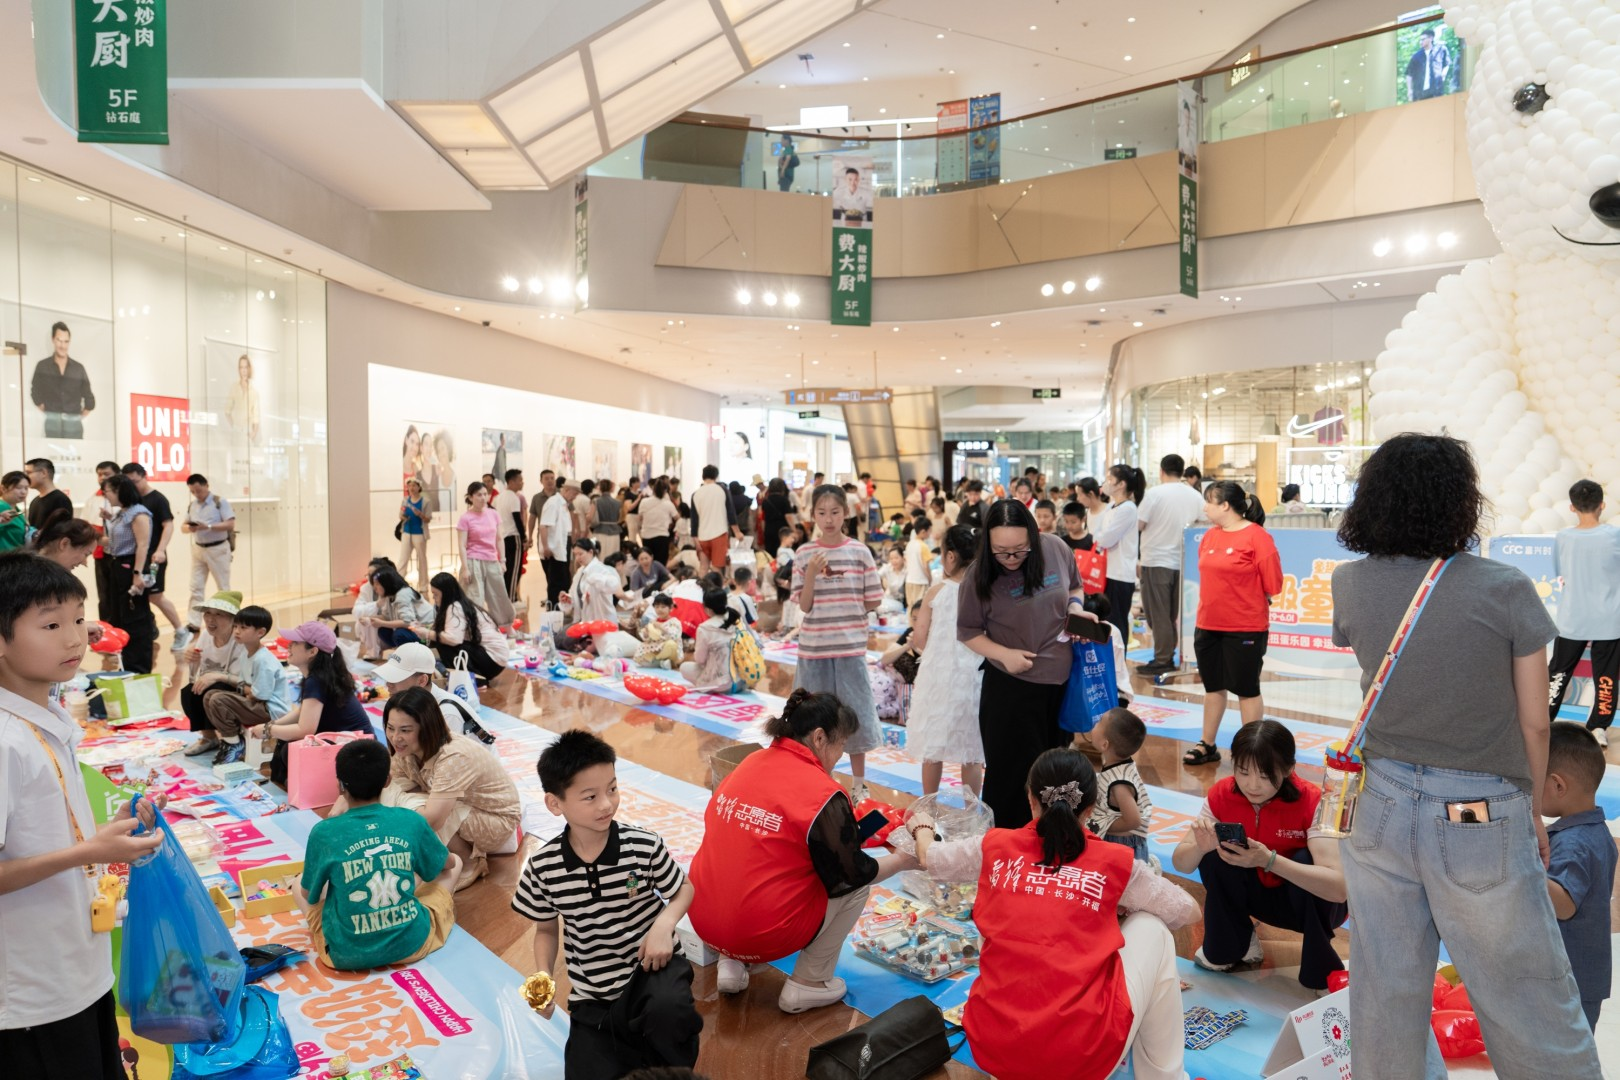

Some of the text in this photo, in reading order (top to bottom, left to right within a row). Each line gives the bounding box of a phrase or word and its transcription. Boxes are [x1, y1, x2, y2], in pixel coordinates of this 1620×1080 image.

[134, 0, 155, 47] 炒肉
[108, 89, 138, 108] 5F
[105, 111, 141, 124] 钻石庭
[837, 233, 856, 292] 费大厨
[844, 300, 859, 310] 5F
[137, 406, 181, 438] UNI
[138, 441, 185, 477] QLO
[1291, 464, 1346, 485] KICKS
[1502, 544, 1524, 555] CFC
[1598, 675, 1613, 716] CHINA
[344, 836, 409, 856] LOOKING AHEAD
[342, 851, 412, 884] NEW YORK
[351, 899, 418, 935] YANKEES
[409, 980, 446, 1017] CHILDREN'S
[439, 1014, 466, 1034] HAPPY
